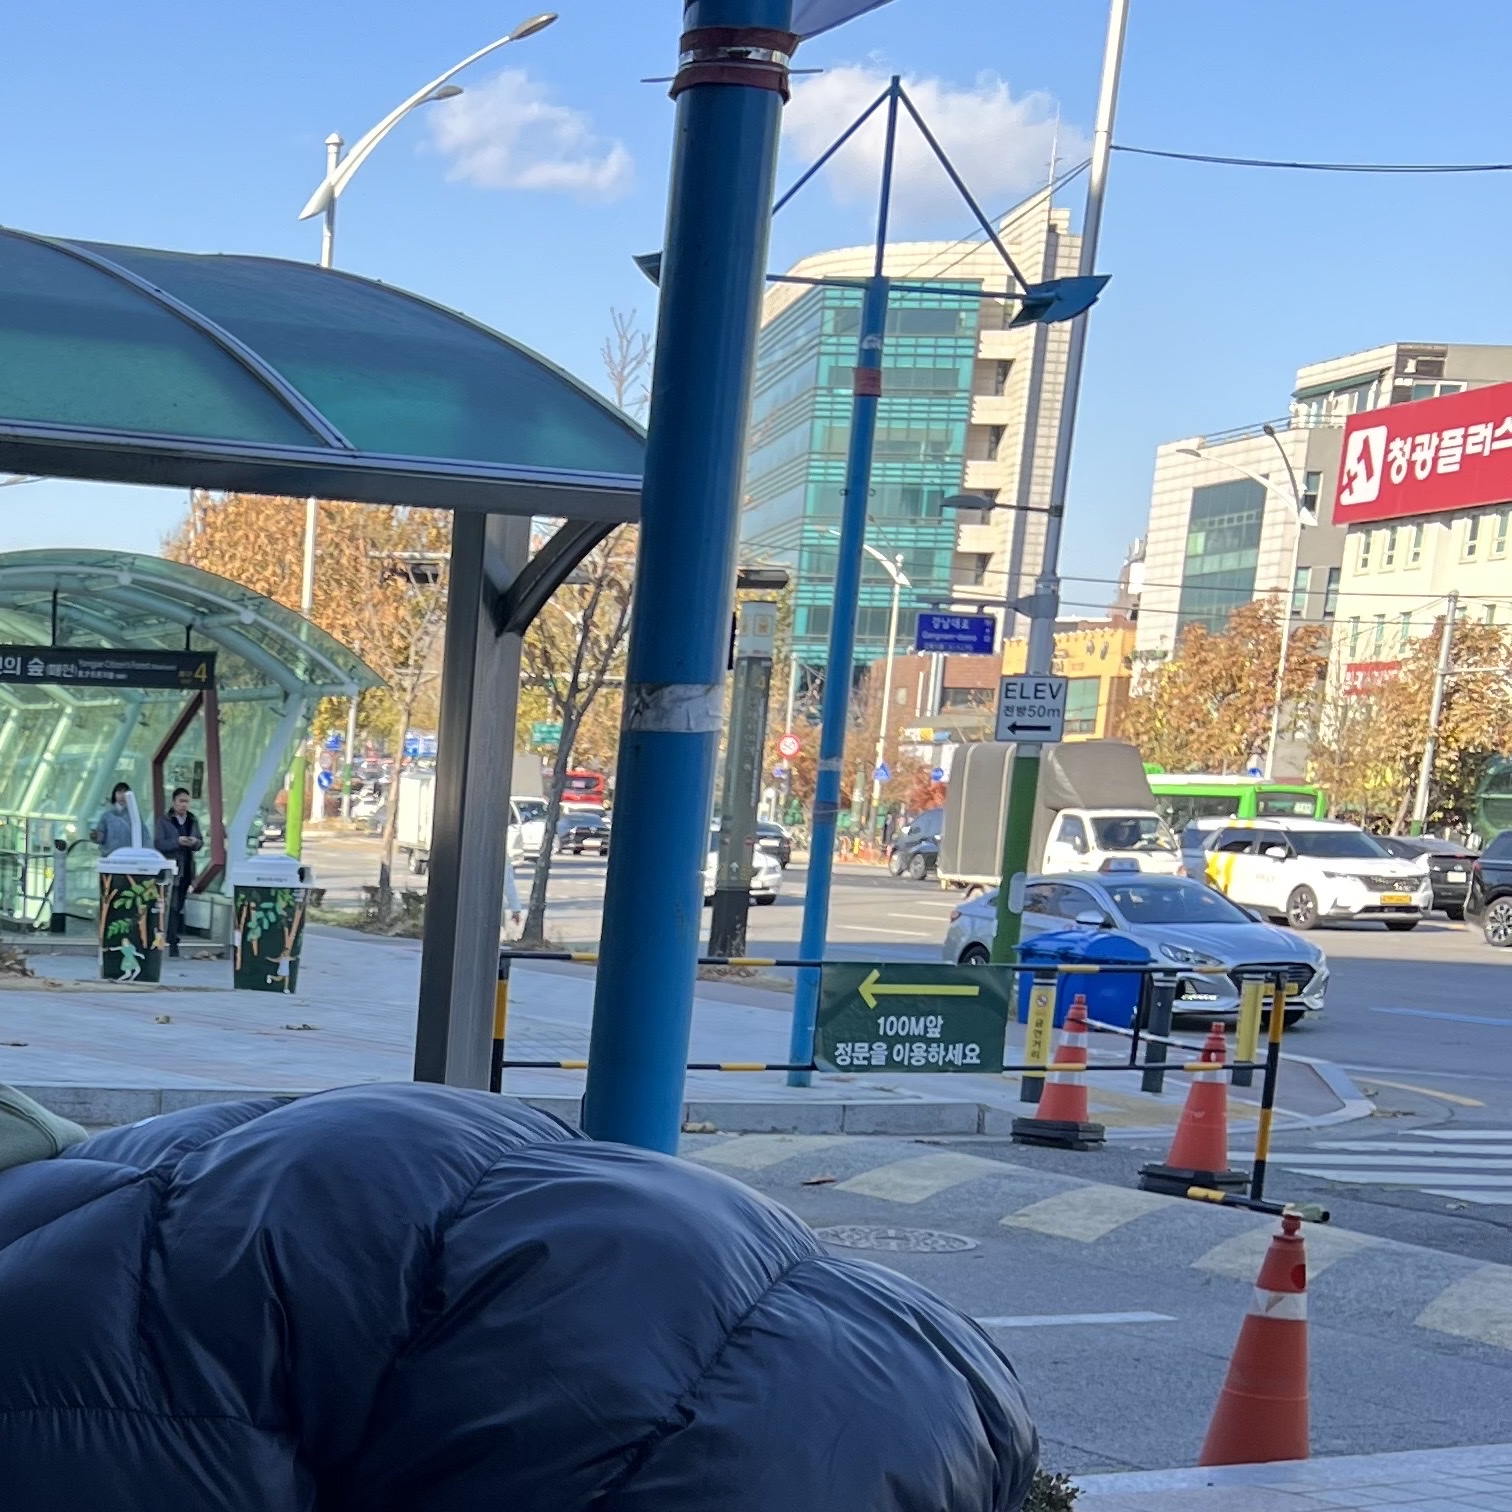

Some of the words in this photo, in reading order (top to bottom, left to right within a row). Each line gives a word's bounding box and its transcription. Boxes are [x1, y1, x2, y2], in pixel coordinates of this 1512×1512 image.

[27, 657, 45, 677] 숲
[1004, 682, 1063, 700] ELEV
[1003, 704, 1061, 718] 전방50m
[877, 1015, 944, 1038] 100M앞
[834, 1042, 889, 1066] 정문을
[892, 1042, 981, 1067] 이용하세요
